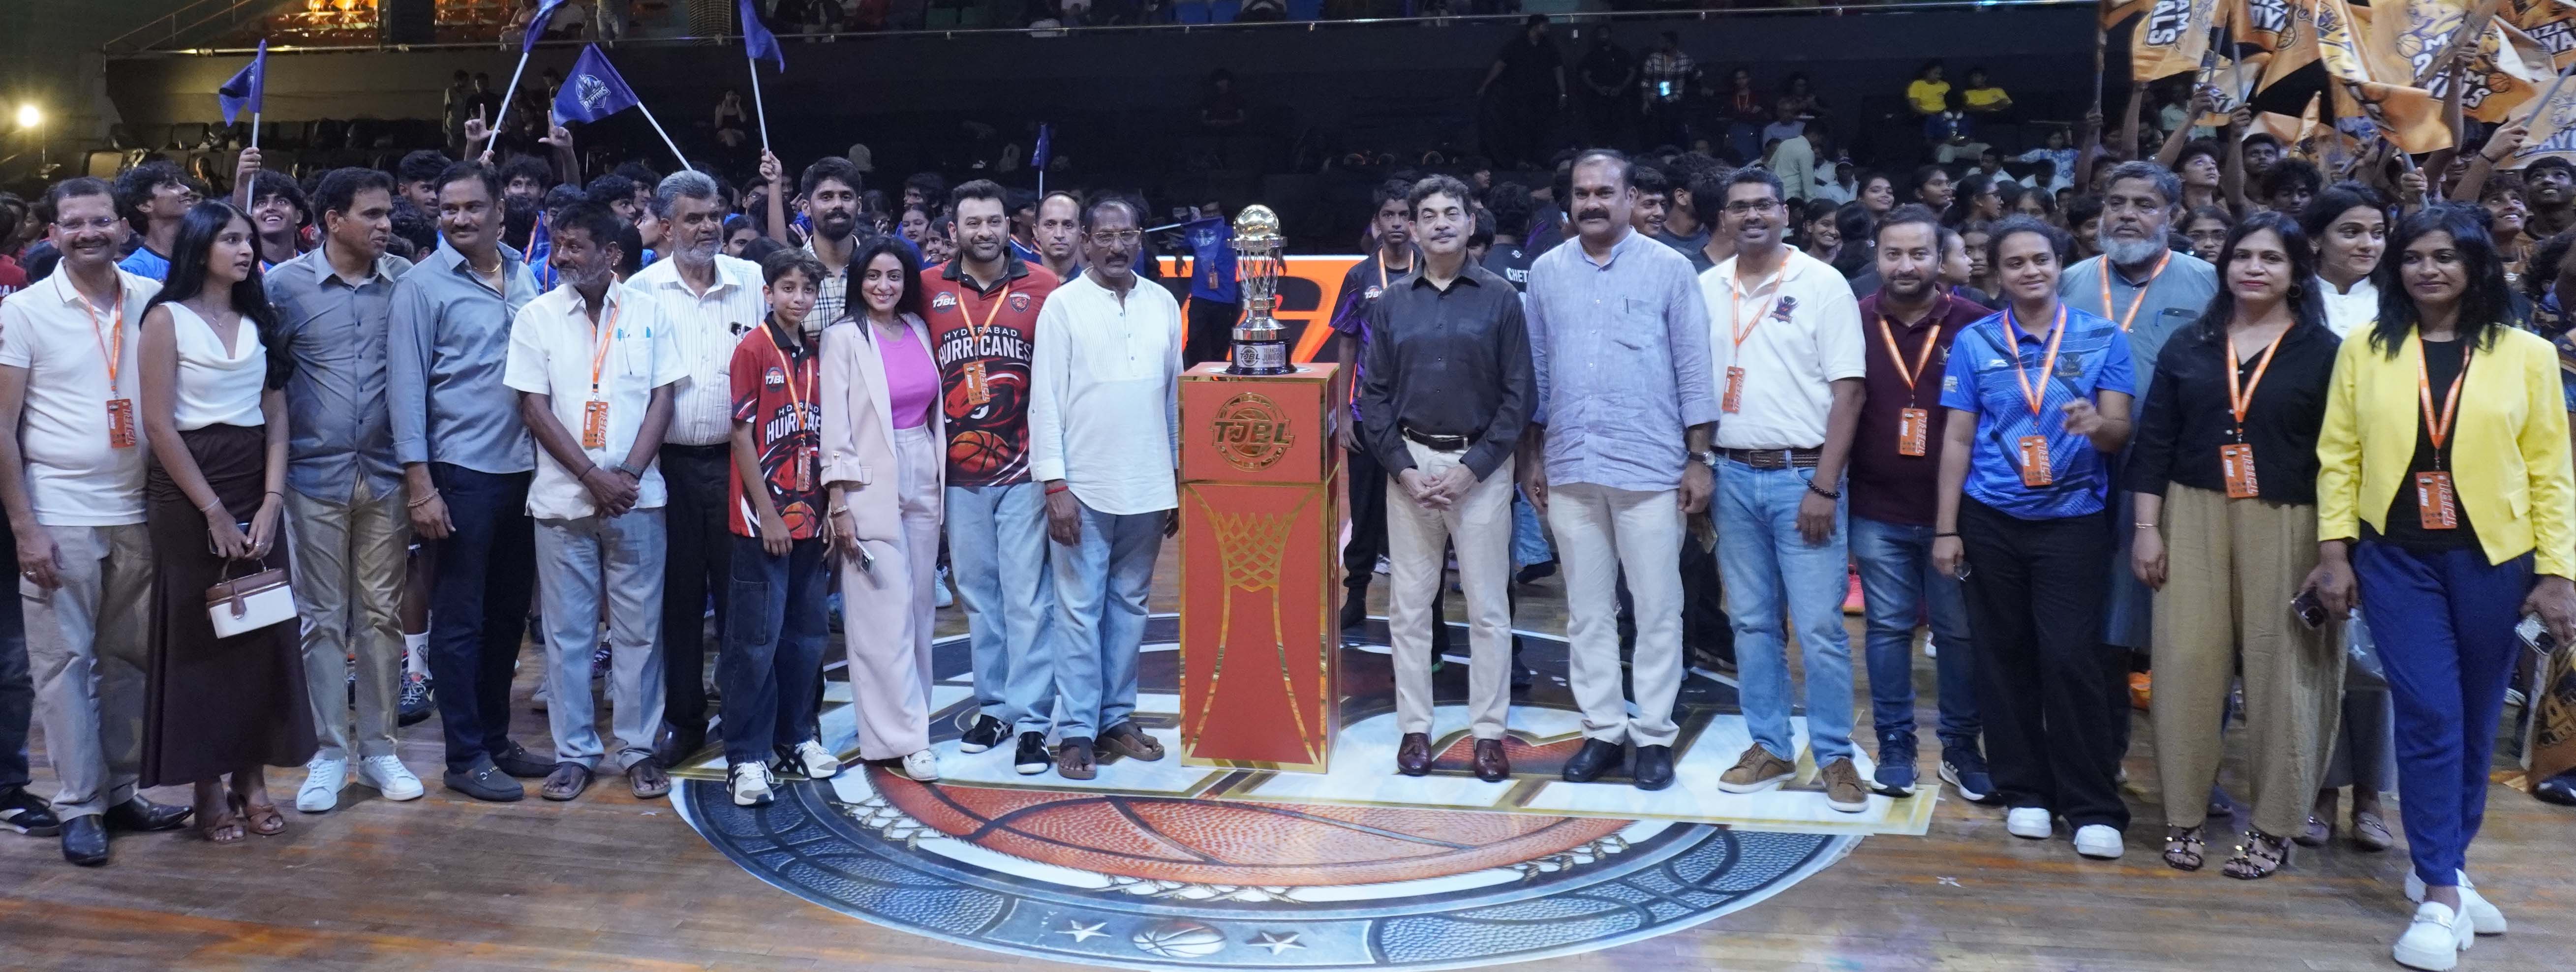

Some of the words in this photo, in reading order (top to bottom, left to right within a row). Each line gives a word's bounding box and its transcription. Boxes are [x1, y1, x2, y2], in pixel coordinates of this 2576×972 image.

[583, 86, 610, 111] RAPTORS
[1506, 268, 1531, 282] CHET
[932, 298, 957, 308] TJBL
[944, 326, 1017, 341] HYDRABAD
[1262, 353, 1283, 362] JUNIORS
[1215, 422, 1290, 443] TJBL
